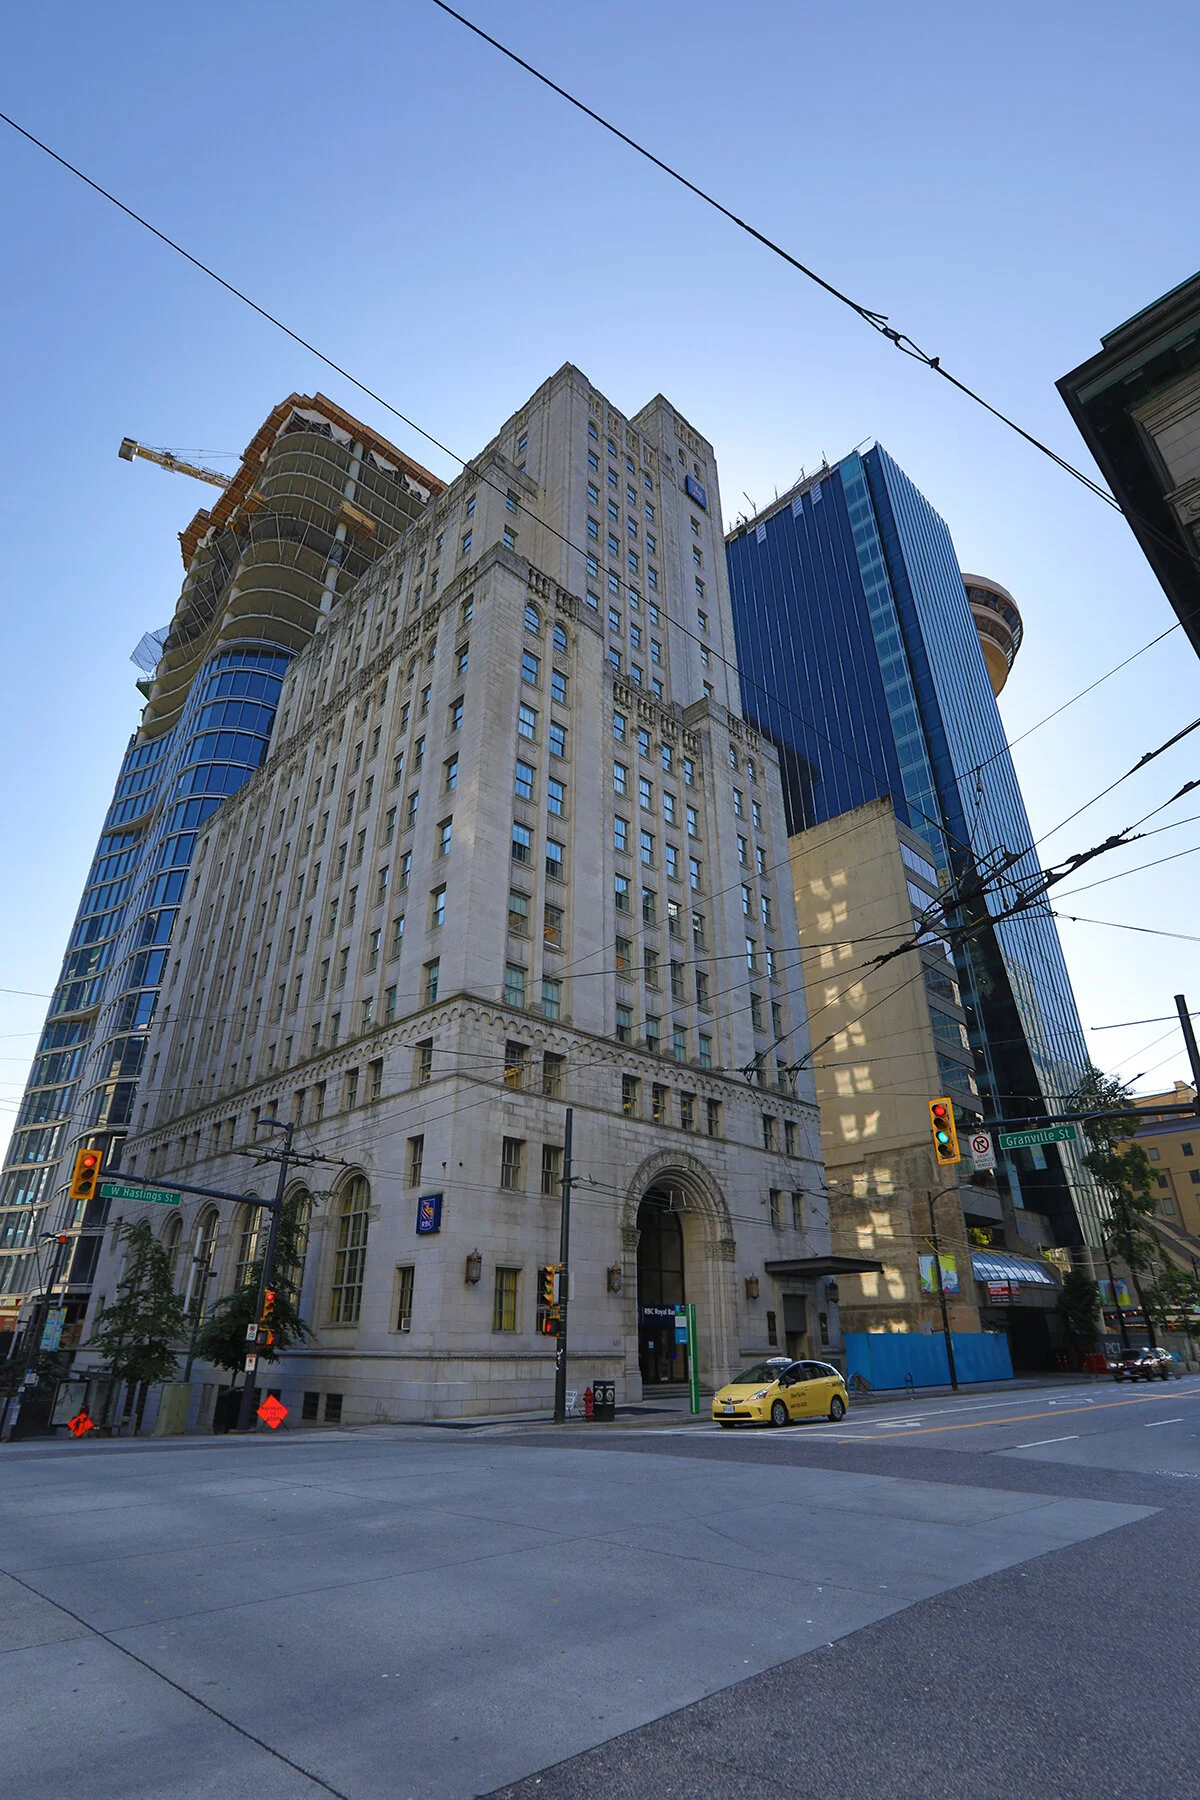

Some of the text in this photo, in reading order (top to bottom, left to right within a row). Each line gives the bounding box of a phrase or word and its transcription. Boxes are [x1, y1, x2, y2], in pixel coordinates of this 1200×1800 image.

[1006, 1128, 1070, 1147] Granville St
[110, 1186, 174, 1203] W Hastings St
[421, 1219, 432, 1227] RBC
[644, 1307, 655, 1315] RBC
[655, 1308, 668, 1317] Royal
